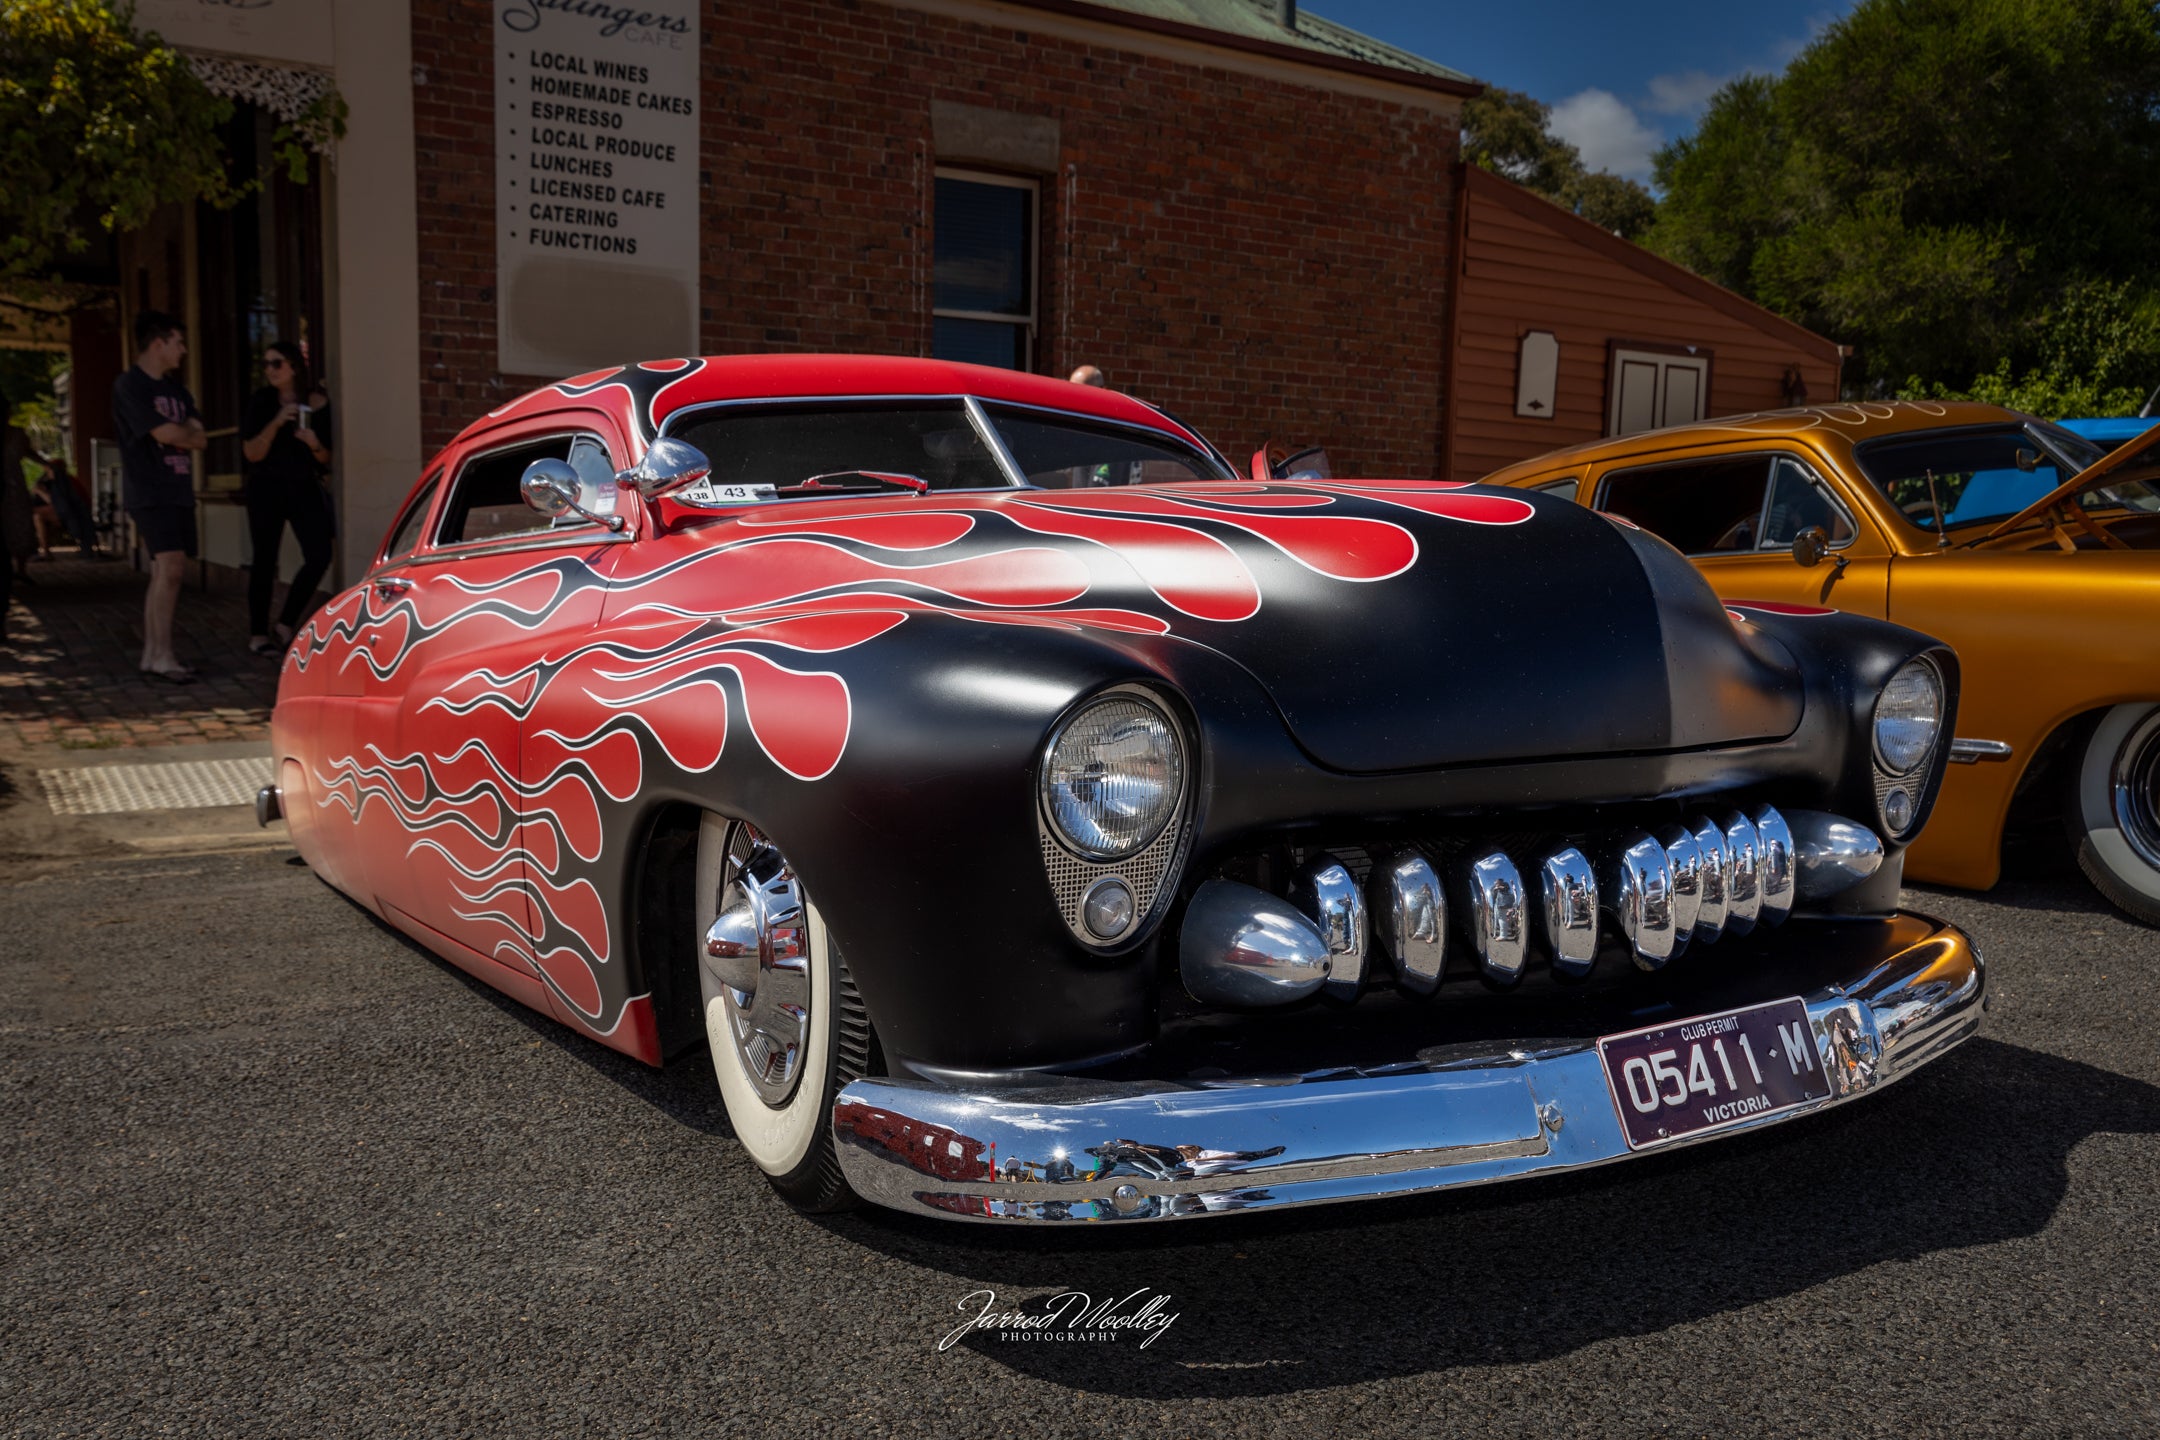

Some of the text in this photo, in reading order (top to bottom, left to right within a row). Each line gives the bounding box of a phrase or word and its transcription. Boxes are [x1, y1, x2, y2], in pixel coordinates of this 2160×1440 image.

[624, 27, 683, 51] CAFE
[531, 50, 648, 84] LOCAL WINES
[531, 76, 692, 115] HOMEMADE CAKES
[531, 101, 623, 129] ESPRESSO
[532, 127, 675, 162] LOCAL PRODUCE
[531, 152, 614, 178] LUNCHES
[531, 177, 664, 209] LICENSED CAFE
[530, 203, 617, 228] CATERING
[530, 228, 636, 254] FUNCTIONS
[724, 487, 746, 497] 43
[1703, 1094, 1771, 1123] VICTORIA
